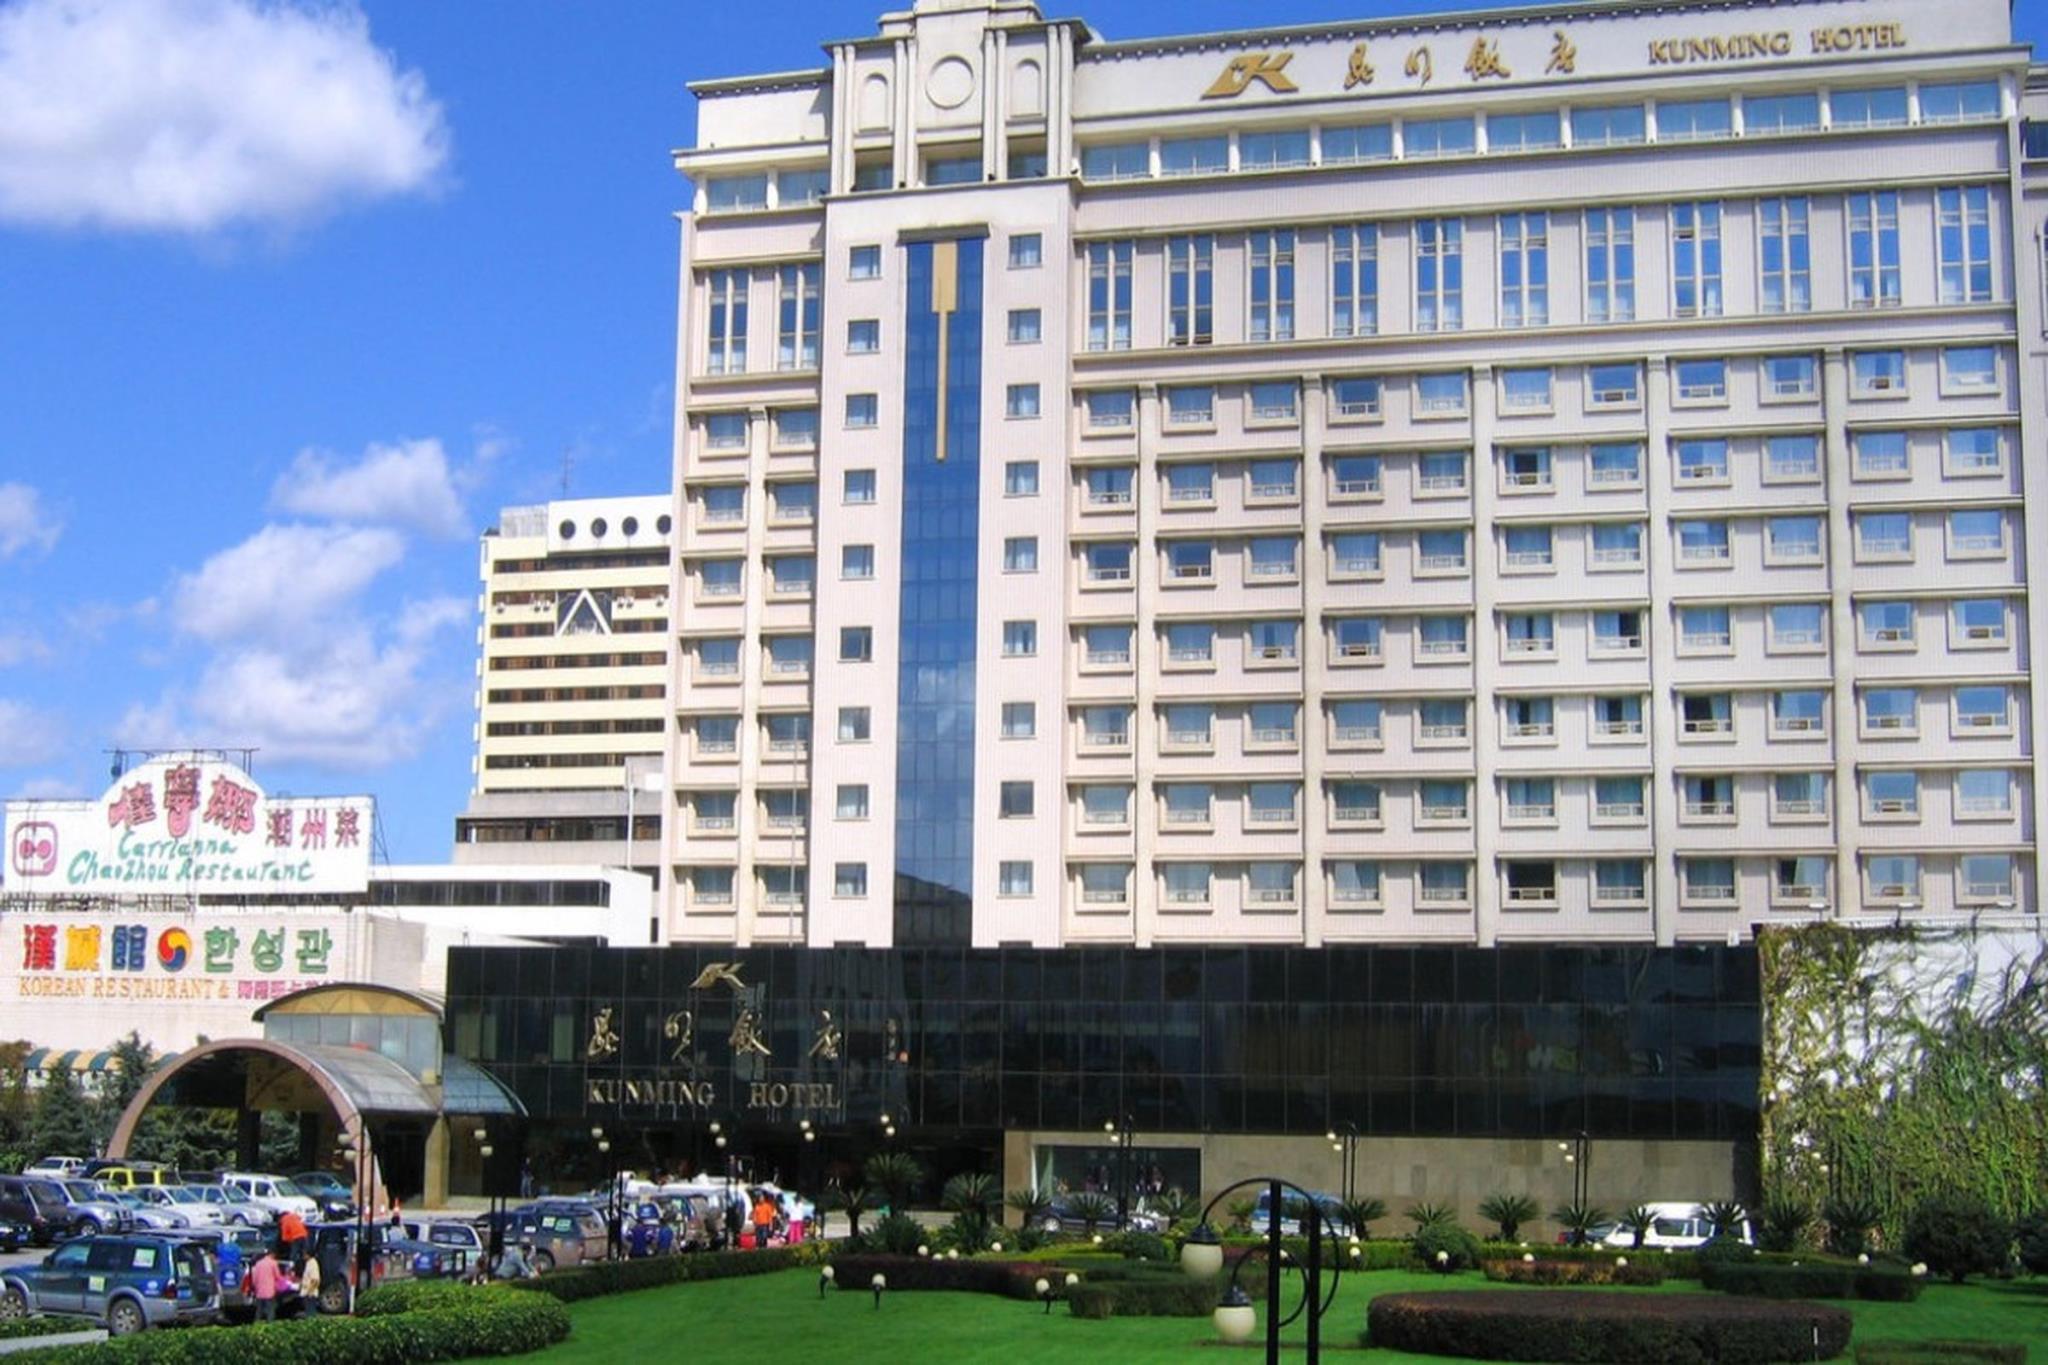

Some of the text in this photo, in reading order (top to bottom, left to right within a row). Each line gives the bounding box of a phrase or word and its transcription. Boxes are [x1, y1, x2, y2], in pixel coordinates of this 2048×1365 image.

[1648, 22, 1907, 64] KUNMING HOTEL
[118, 830, 238, 860] Carrianna
[175, 857, 315, 883] Restaurant
[204, 925, 333, 974] 한성관
[19, 976, 87, 997] KOREAN
[93, 977, 214, 999] RESTAURANT
[587, 1079, 842, 1109] KUNMING HOTEL
